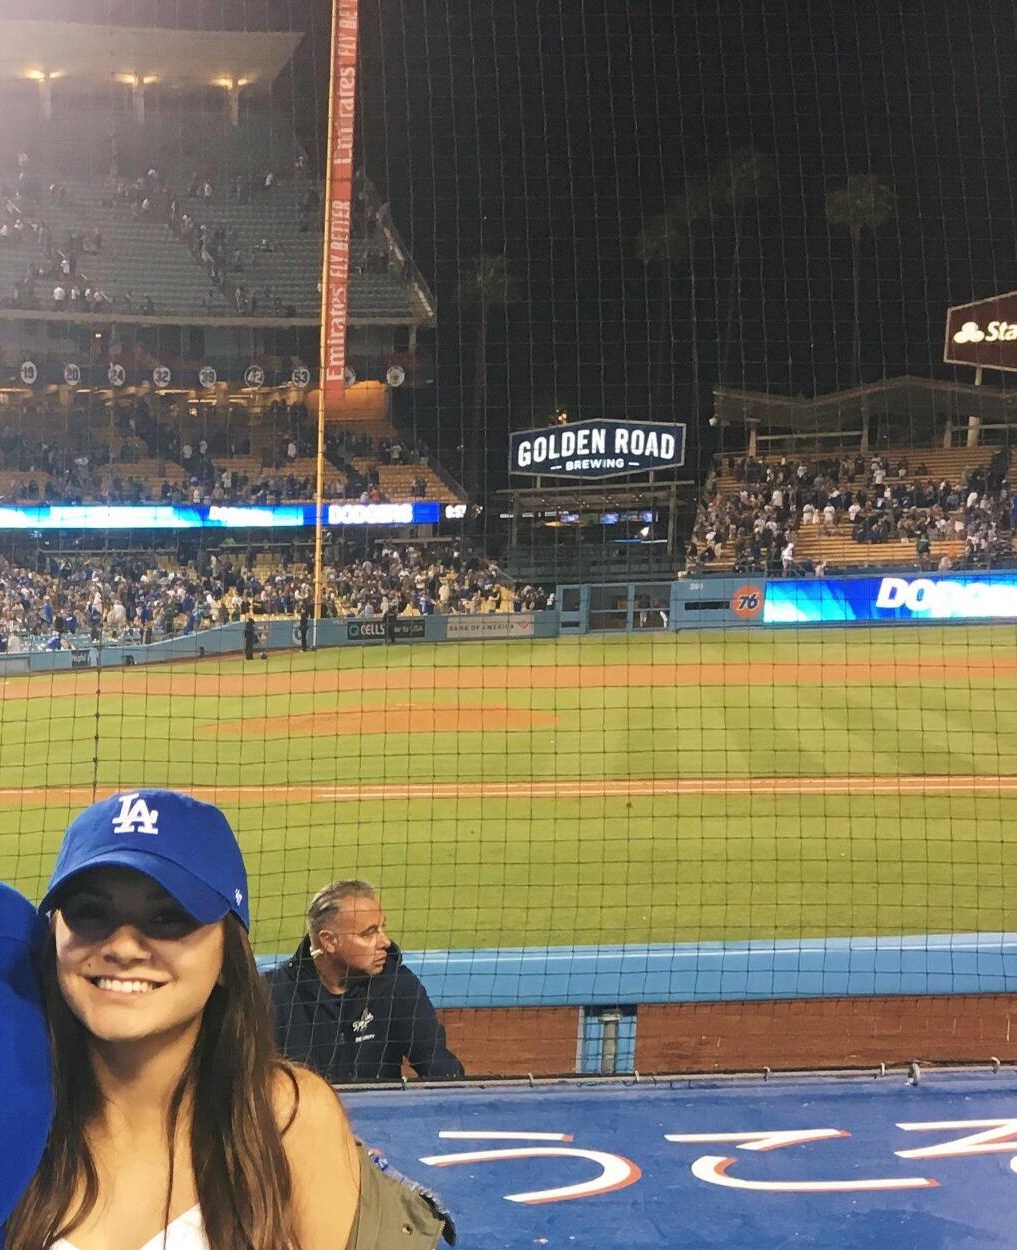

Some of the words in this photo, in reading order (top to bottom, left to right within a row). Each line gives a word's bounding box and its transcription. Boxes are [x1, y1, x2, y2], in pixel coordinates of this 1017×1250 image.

[334, 66, 356, 165] Emirates
[330, 200, 352, 252] BETTER
[329, 256, 349, 279] FLY
[326, 284, 346, 382] Emirates
[518, 428, 607, 468] GOLDEN
[615, 427, 675, 460] ROAD
[565, 458, 625, 471] BREWING
[738, 592, 760, 611] 76
[361, 624, 385, 636] CELLS
[112, 793, 159, 835] LA
